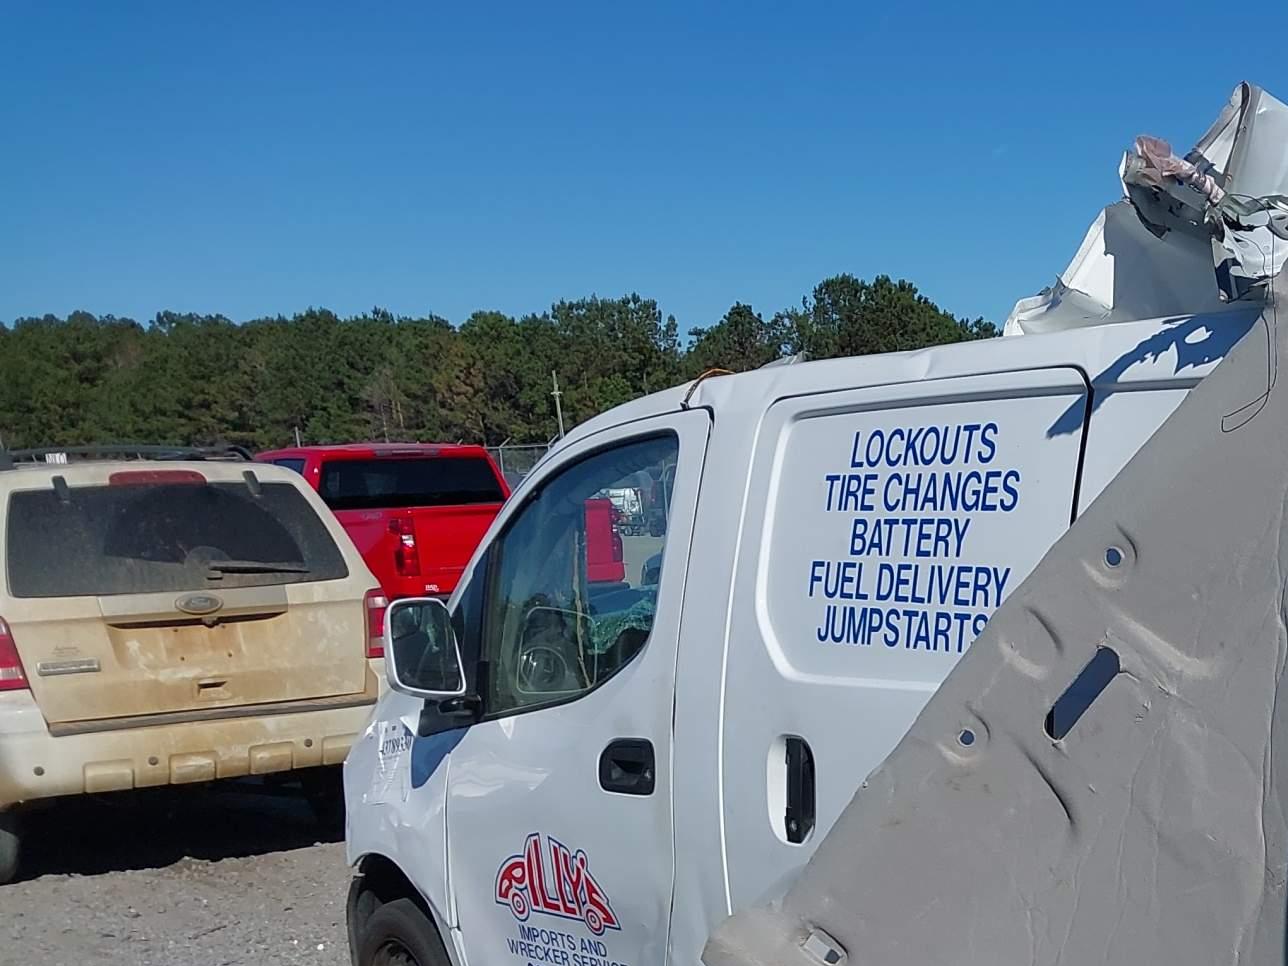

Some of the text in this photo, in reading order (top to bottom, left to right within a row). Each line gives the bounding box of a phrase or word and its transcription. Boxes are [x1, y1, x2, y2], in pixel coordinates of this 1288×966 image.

[851, 422, 998, 468] LOCKOUTS
[826, 470, 1021, 511] TIRE CHANGES
[850, 518, 970, 557] BATTERY
[809, 561, 1010, 607] FUEL DELIVERY
[507, 938, 569, 966] WRECKER
[519, 924, 607, 958] IMPORTS AND
